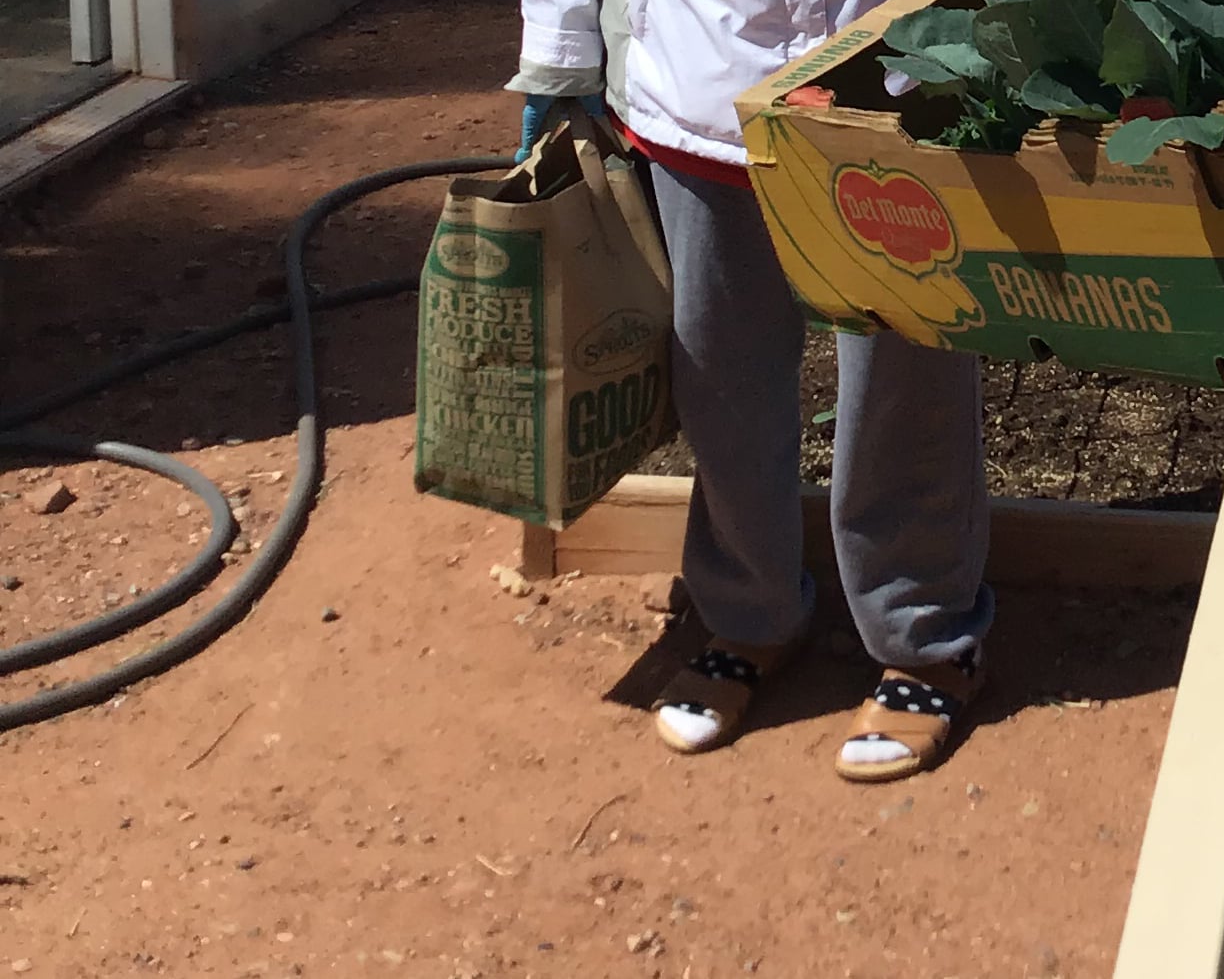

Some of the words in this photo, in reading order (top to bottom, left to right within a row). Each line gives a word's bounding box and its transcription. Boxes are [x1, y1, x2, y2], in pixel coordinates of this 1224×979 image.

[770, 29, 875, 88] BANANAS
[843, 192, 880, 222] Del
[876, 198, 944, 231] Monte
[425, 282, 533, 323] FRESH
[987, 261, 1174, 335] BANANAS
[568, 363, 660, 460] GOOD
